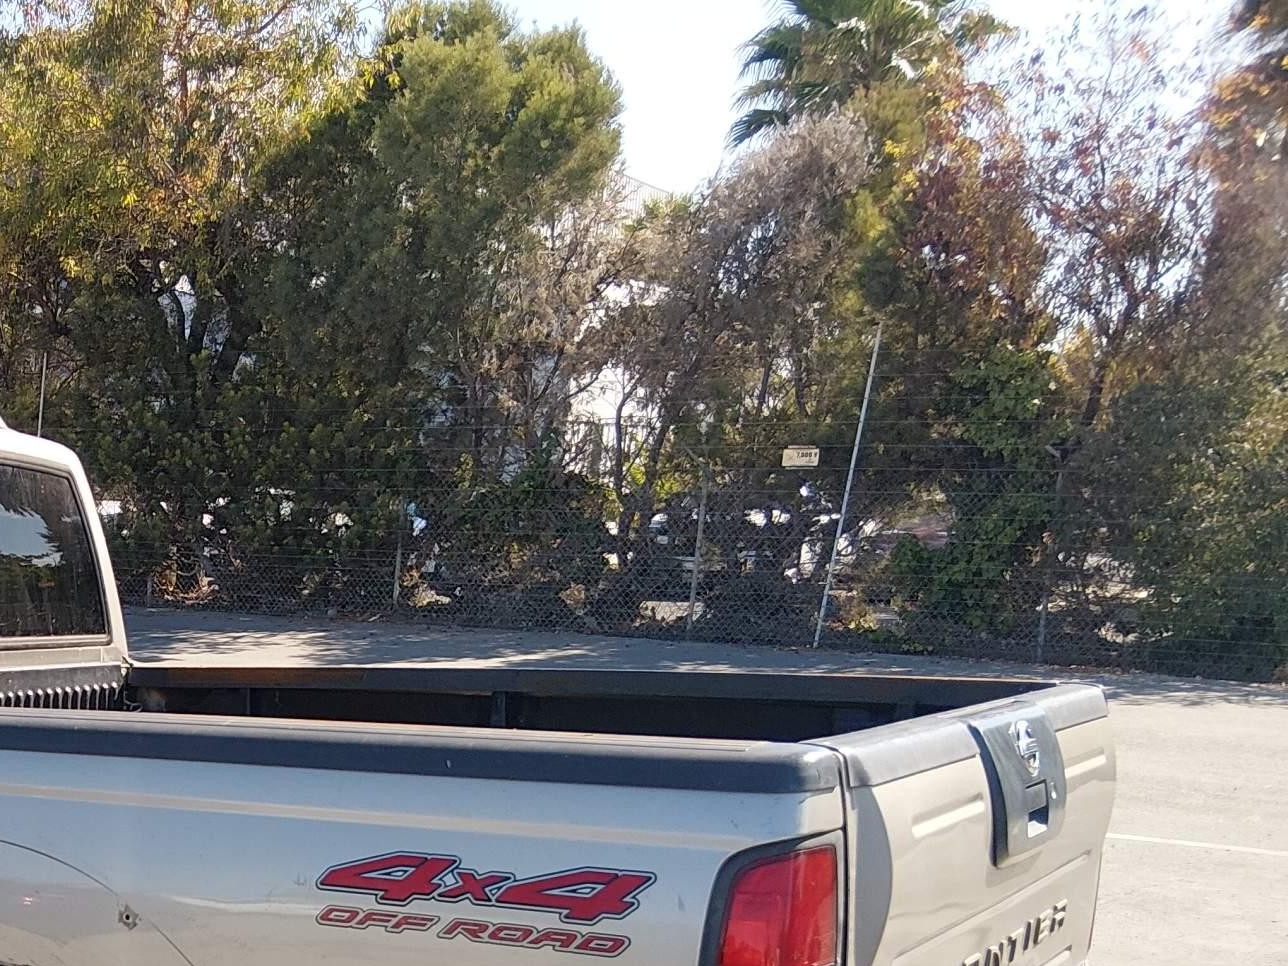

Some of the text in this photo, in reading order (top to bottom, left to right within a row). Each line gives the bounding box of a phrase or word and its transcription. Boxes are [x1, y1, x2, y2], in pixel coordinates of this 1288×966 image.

[316, 851, 657, 925] 4x4
[317, 905, 631, 957] OFF ROAD
